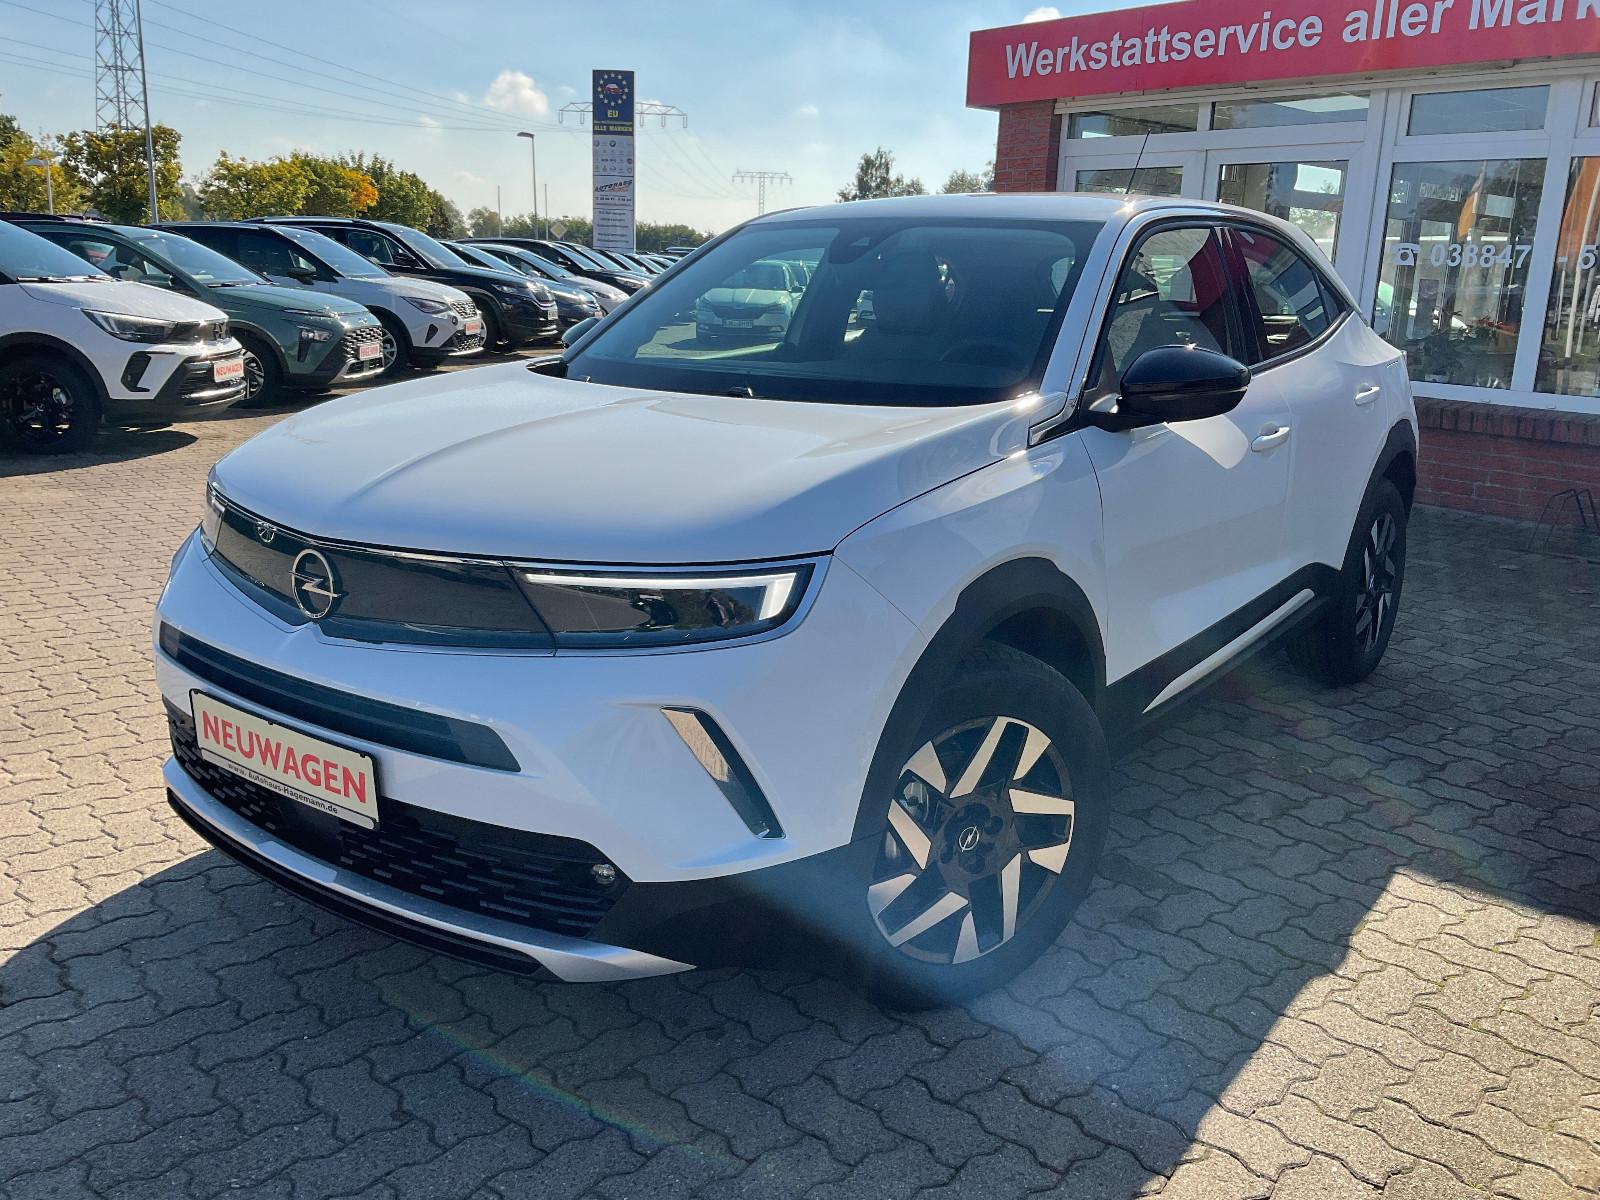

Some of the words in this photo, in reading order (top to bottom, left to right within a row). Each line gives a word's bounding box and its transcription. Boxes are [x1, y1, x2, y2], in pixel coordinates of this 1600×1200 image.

[1005, 12, 1323, 78] Werkstattservice
[1342, 0, 1454, 43] aller
[607, 109, 619, 118] EU
[1430, 244, 1532, 269] 038847
[216, 364, 243, 376] NEUWAGEN
[202, 710, 367, 804] NEUWAGEN
